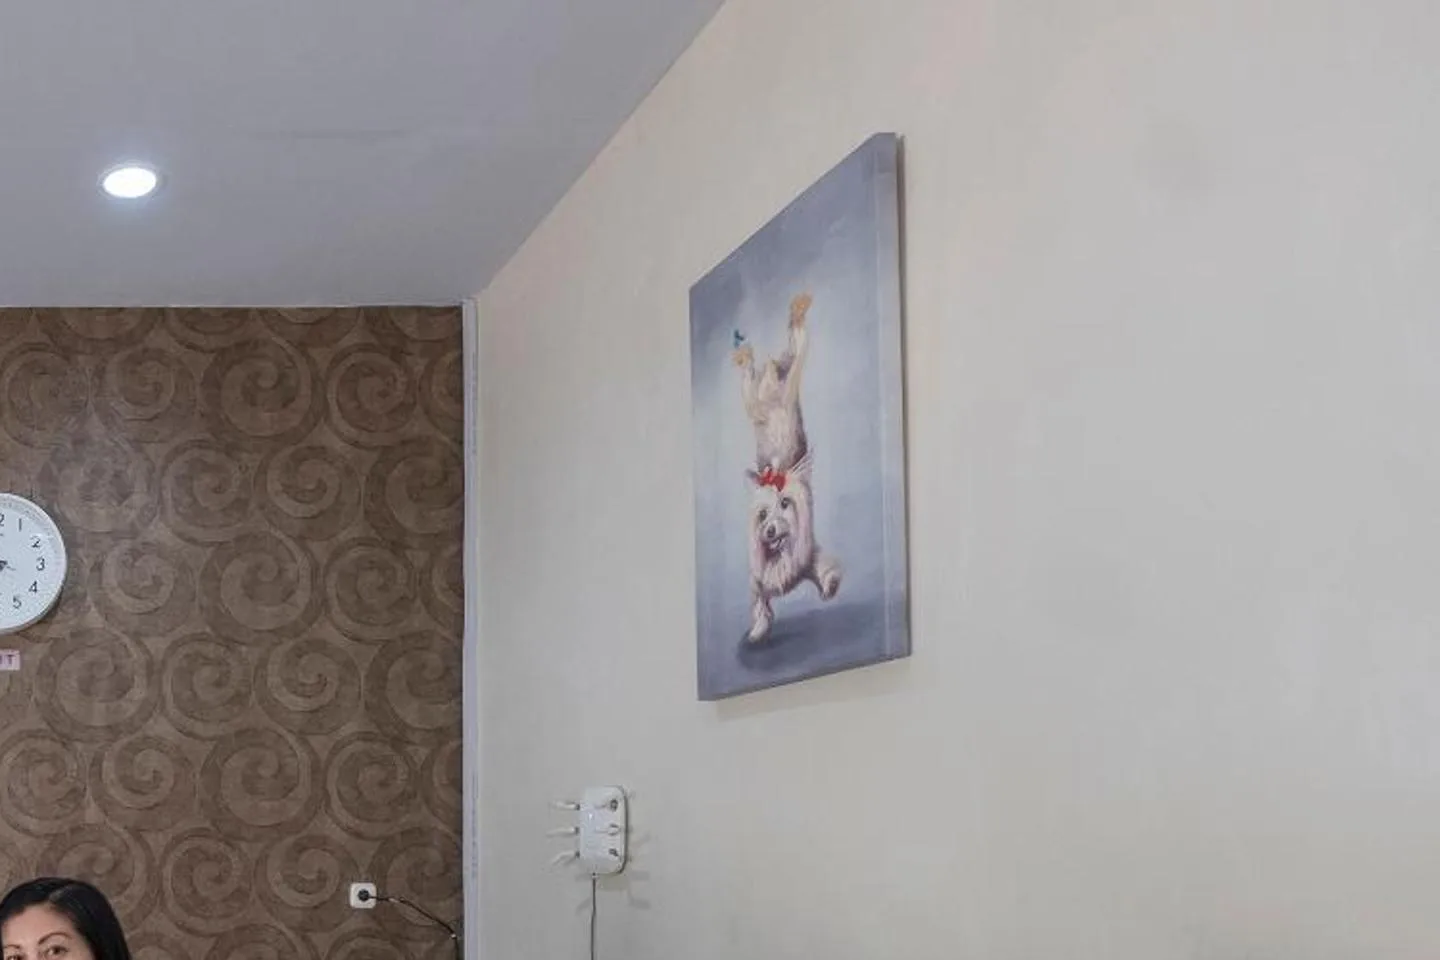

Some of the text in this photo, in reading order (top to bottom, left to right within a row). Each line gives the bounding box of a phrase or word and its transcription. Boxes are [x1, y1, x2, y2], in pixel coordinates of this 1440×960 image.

[31, 536, 42, 549] 2
[36, 557, 45, 571] 3
[28, 580, 38, 594] 4
[12, 596, 22, 609] 5
